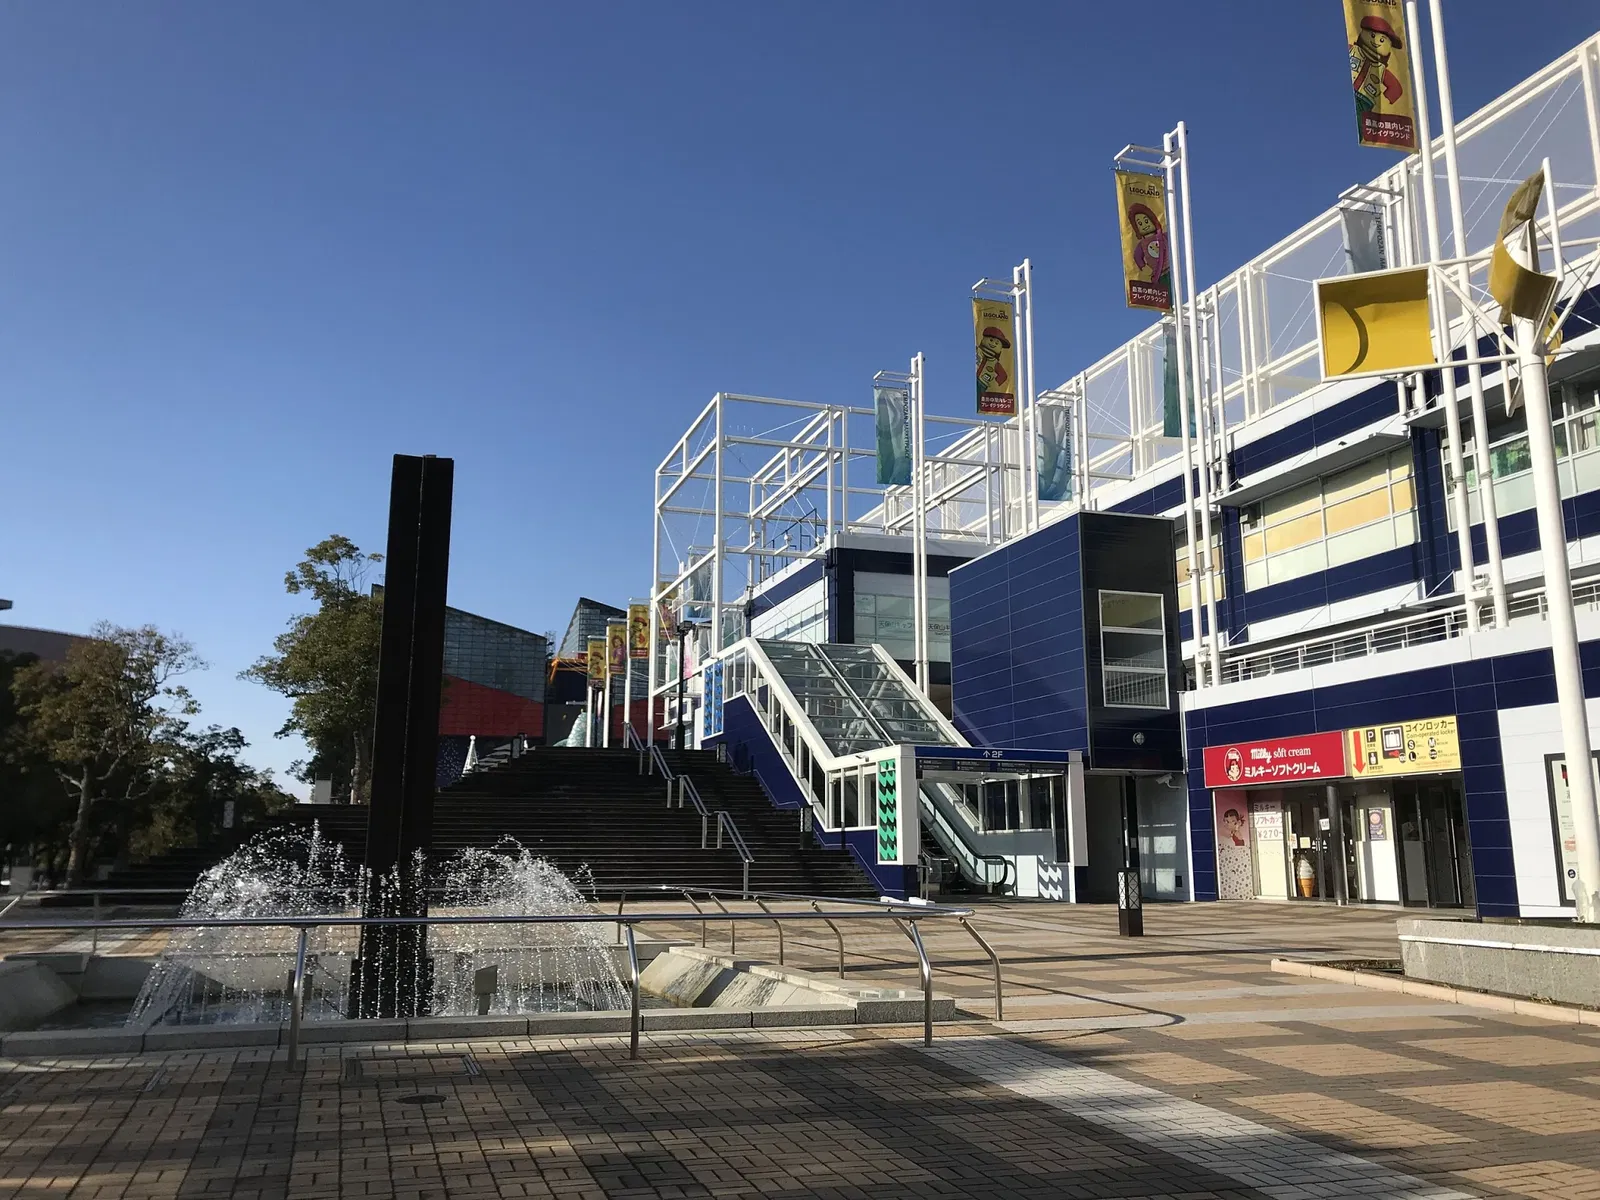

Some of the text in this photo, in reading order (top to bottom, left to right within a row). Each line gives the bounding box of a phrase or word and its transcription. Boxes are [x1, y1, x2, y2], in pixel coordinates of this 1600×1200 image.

[1129, 186, 1160, 197] LEGOLAND
[1405, 720, 1456, 733] コインロッカー
[1406, 731, 1439, 739] Coin-operated
[991, 750, 1003, 758] 2F
[1273, 747, 1288, 759] soft
[1288, 747, 1311, 758] cream
[1244, 761, 1321, 778] ミルキーソフトクリーム
